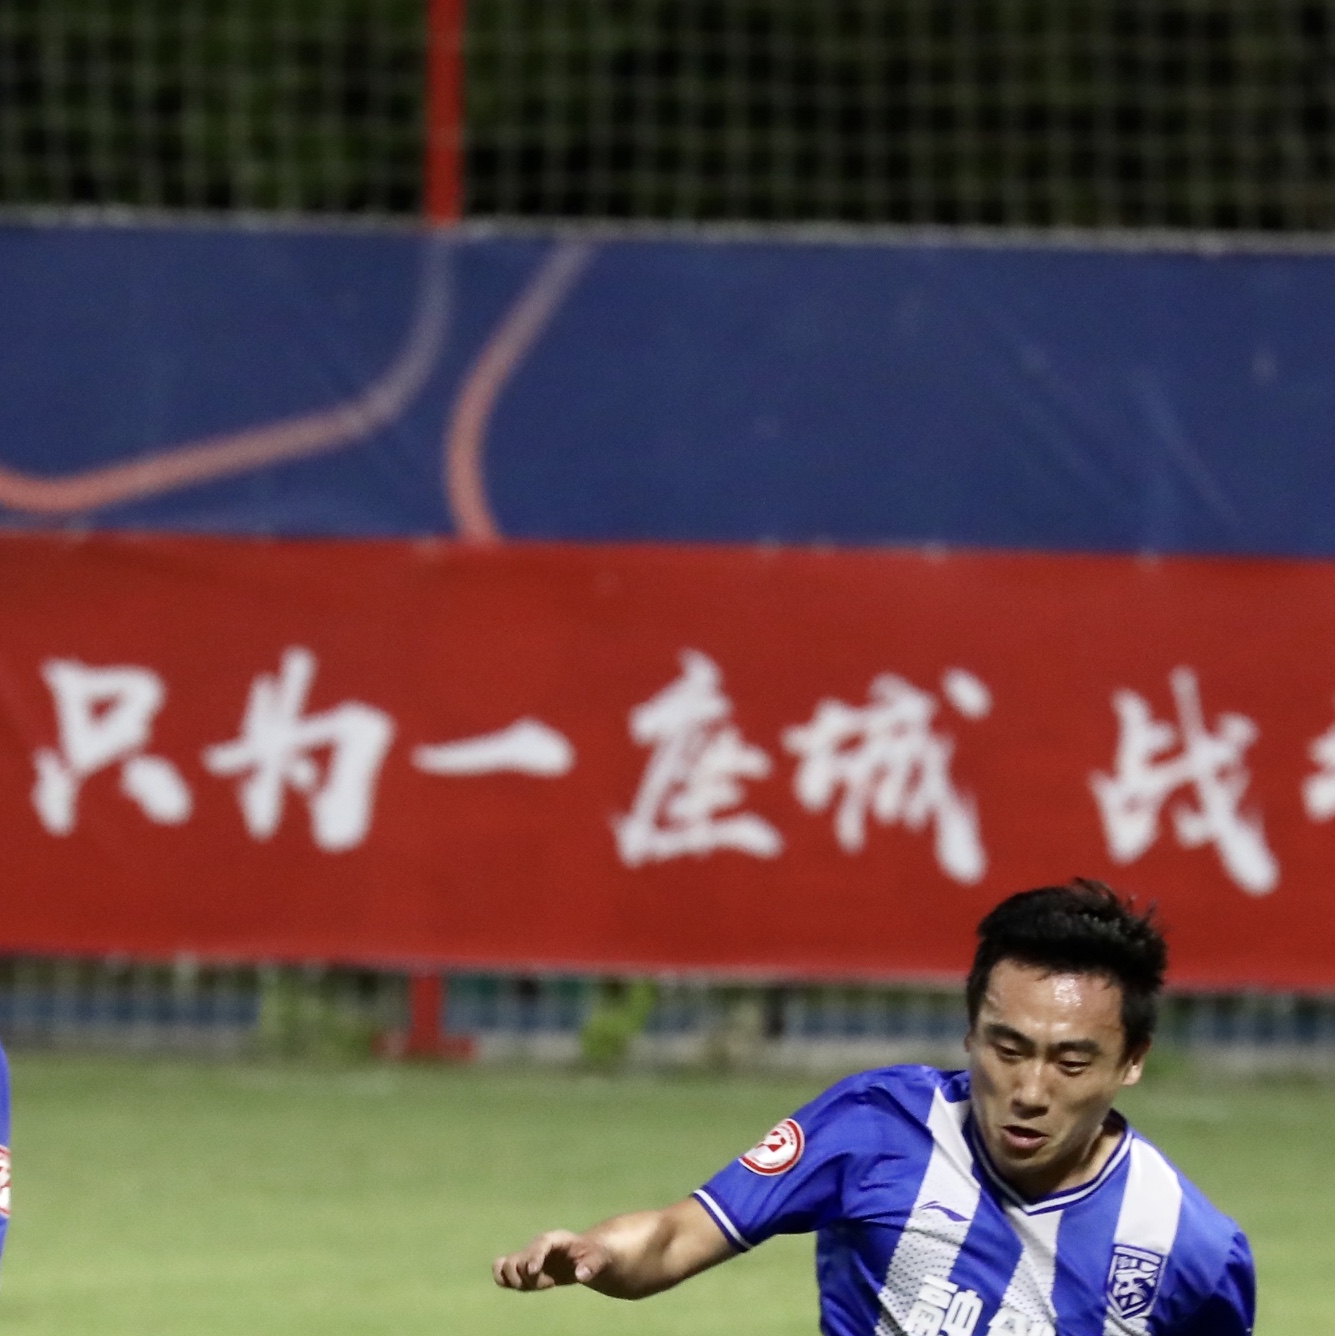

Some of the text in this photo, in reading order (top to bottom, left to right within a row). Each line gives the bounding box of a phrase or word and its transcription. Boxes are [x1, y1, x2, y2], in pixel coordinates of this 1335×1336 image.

[30, 646, 991, 885] 只为一座城
